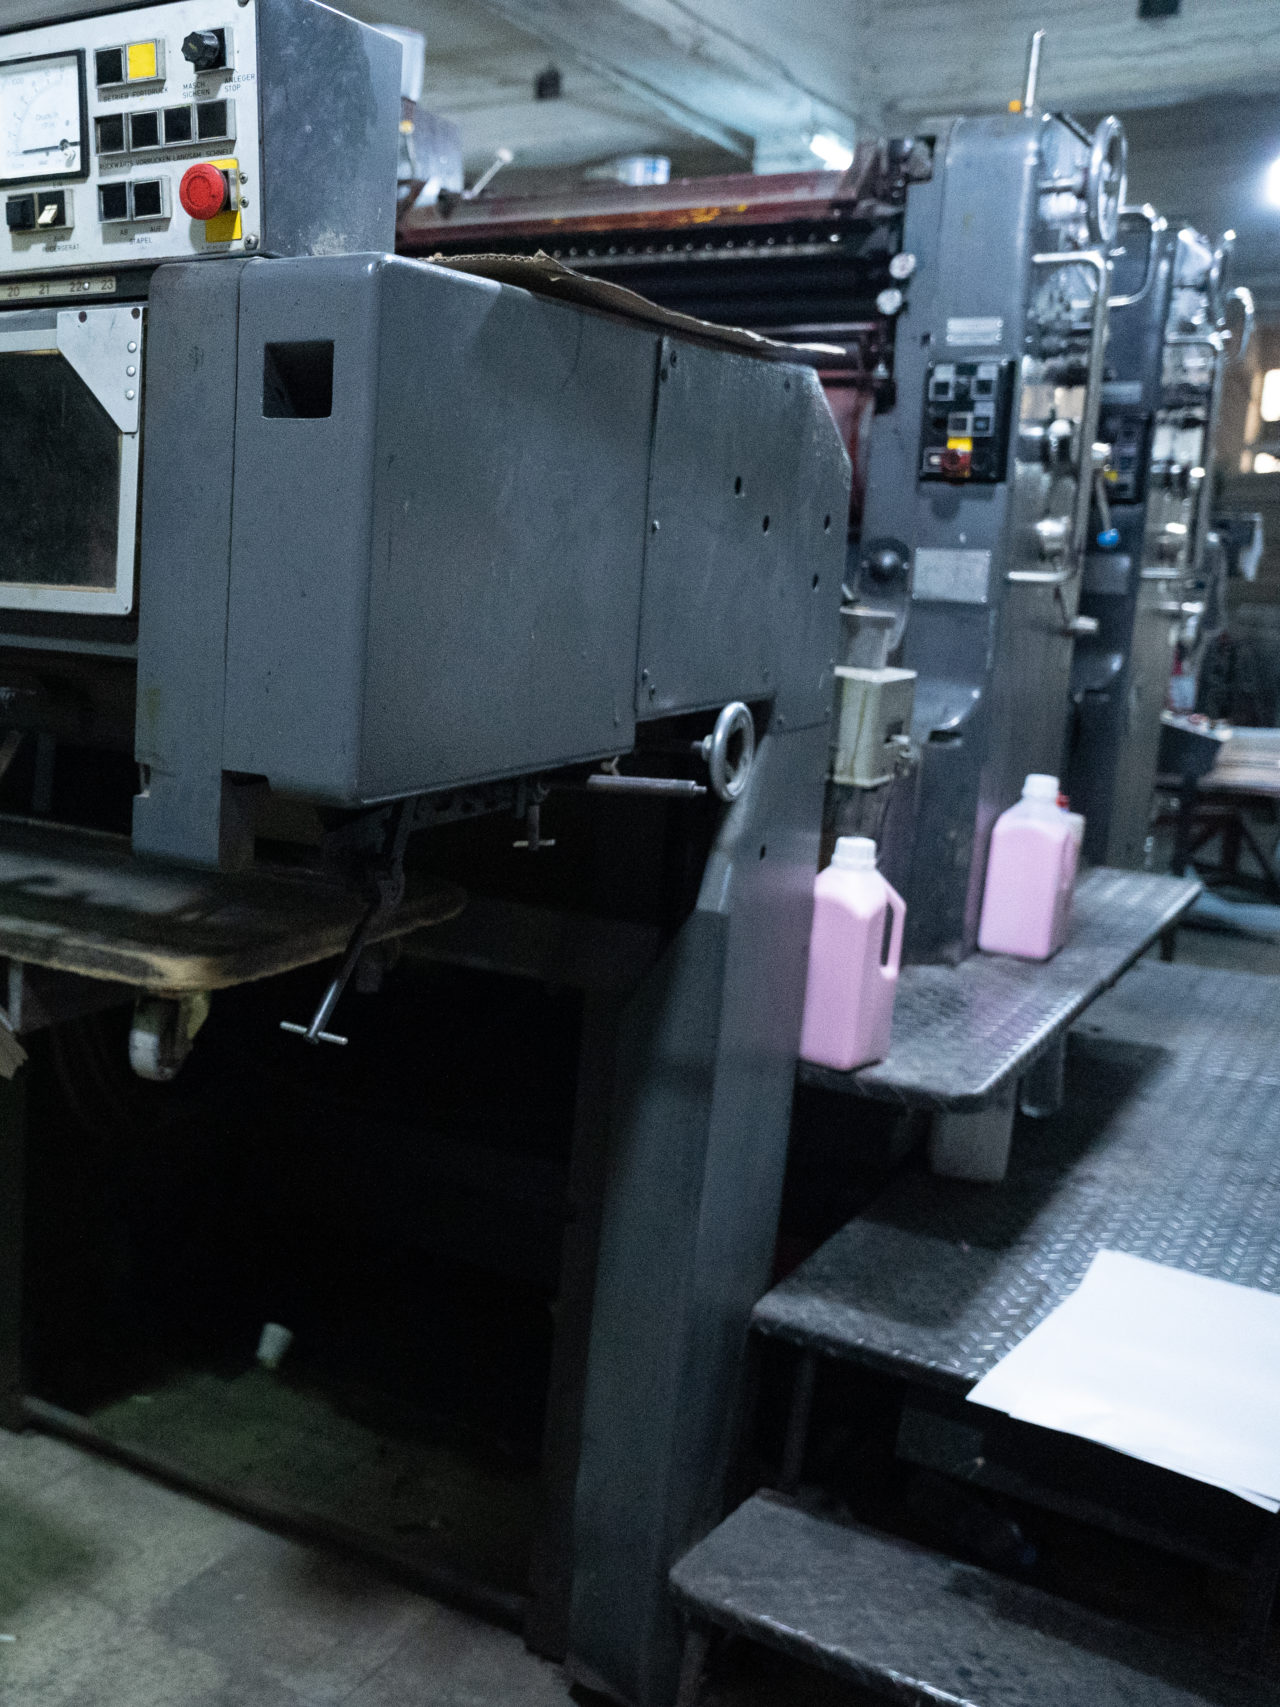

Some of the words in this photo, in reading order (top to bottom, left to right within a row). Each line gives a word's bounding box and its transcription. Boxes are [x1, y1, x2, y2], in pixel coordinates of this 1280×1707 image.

[224, 83, 241, 93] STOP
[7, 286, 20, 297] 20
[39, 283, 50, 294] 21
[101, 279, 114, 290] 23
